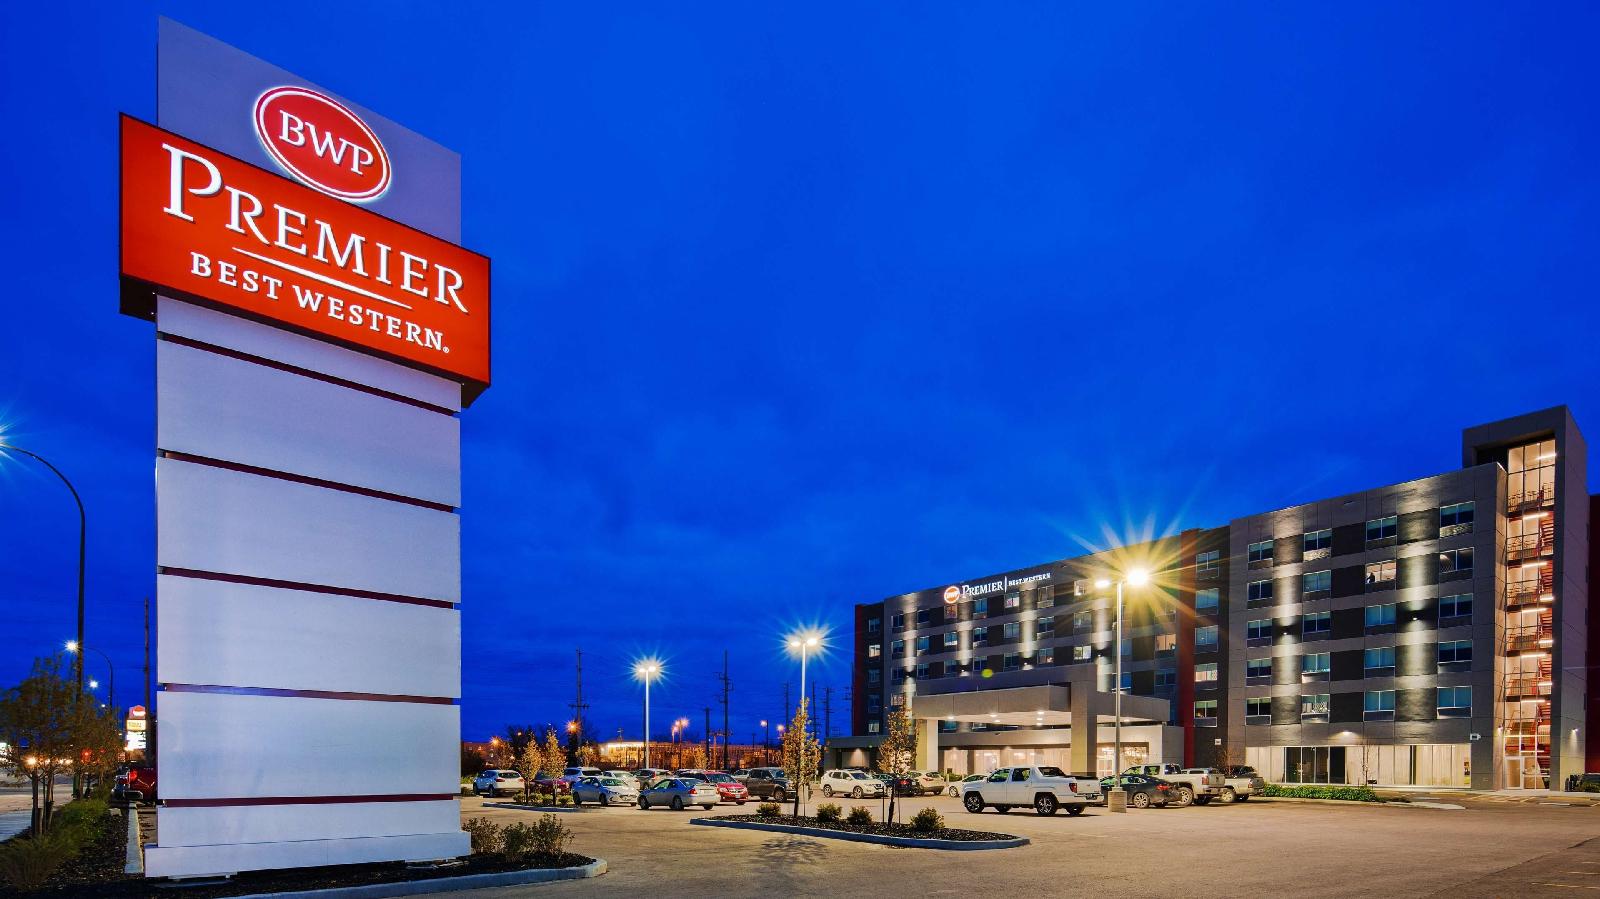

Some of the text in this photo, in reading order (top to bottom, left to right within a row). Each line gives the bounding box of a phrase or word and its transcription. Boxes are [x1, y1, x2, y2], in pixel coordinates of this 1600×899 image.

[279, 110, 374, 176] BWP
[161, 142, 470, 313] PREMIER
[190, 251, 283, 299] BEST
[961, 581, 1004, 599] PREMIER
